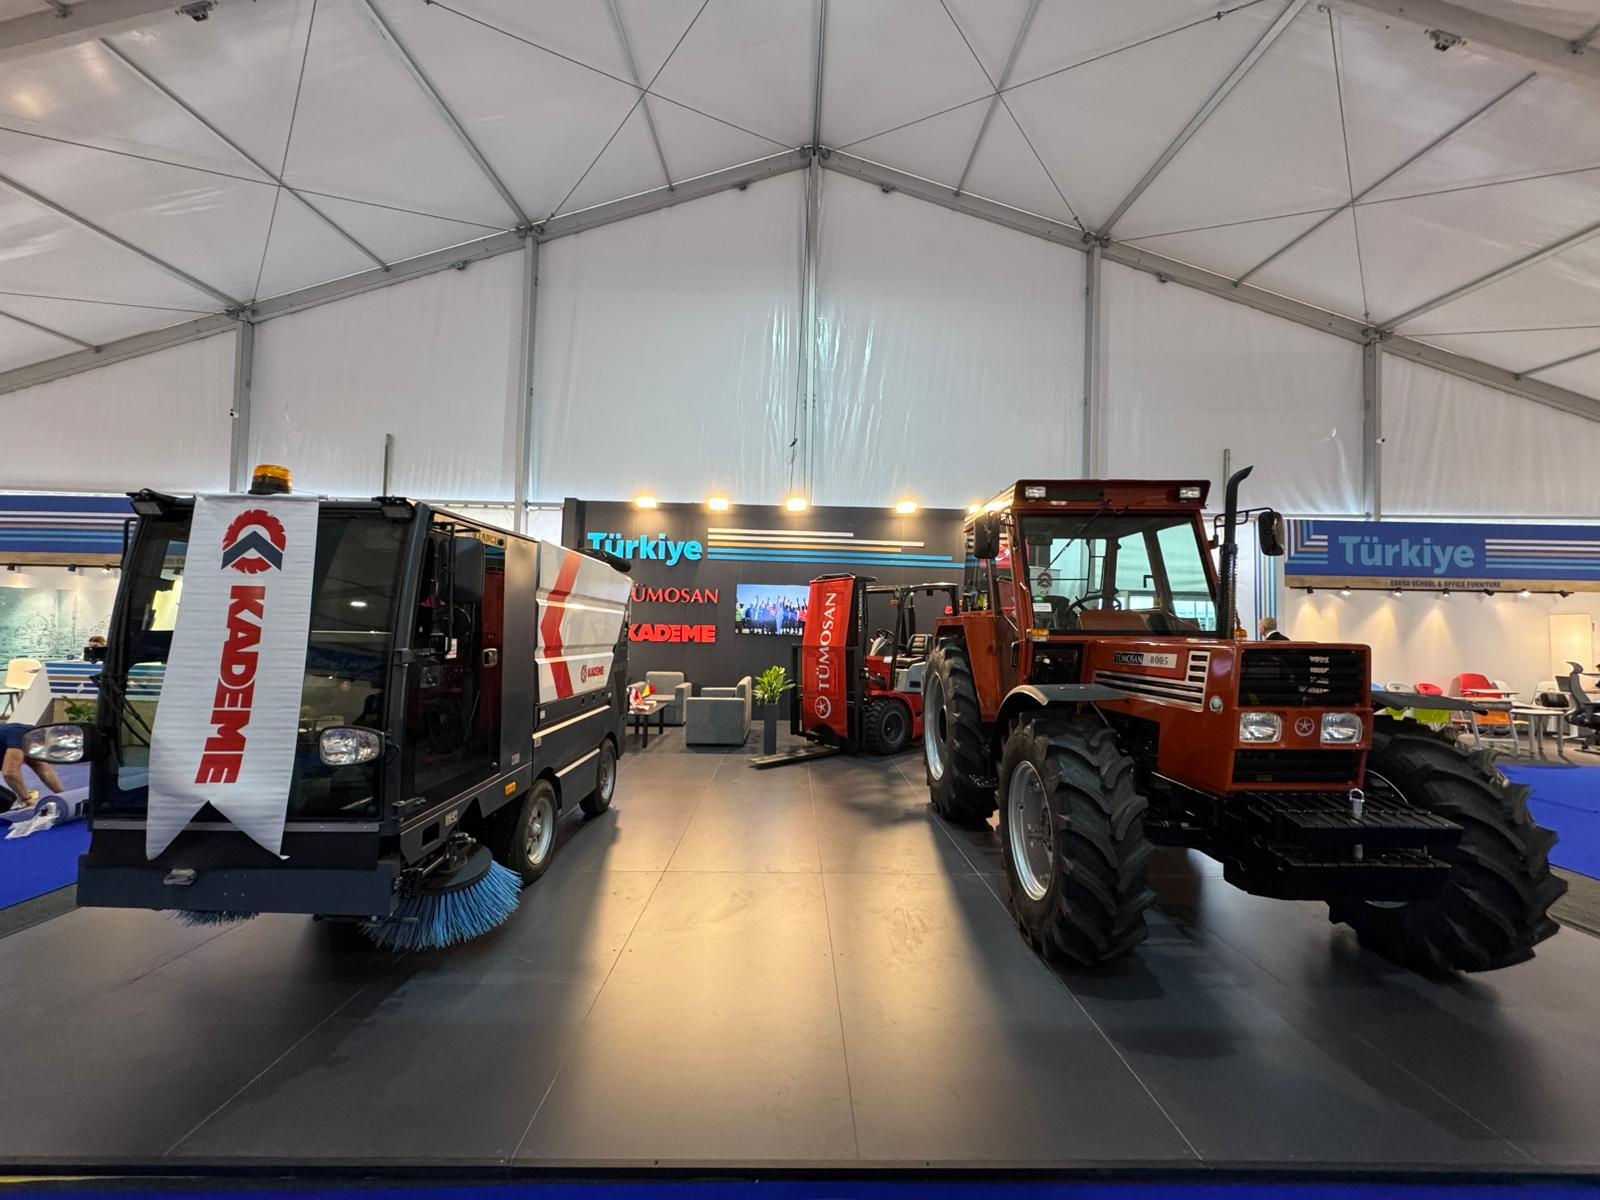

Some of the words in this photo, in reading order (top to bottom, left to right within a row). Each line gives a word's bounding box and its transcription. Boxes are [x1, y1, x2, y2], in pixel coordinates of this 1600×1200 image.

[587, 532, 703, 567] Türkiye
[1338, 535, 1475, 575] Türkiye
[631, 583, 719, 604] ÜMOSAN
[815, 592, 837, 690] TÜMOSAN
[1150, 655, 1169, 665] 8005
[193, 585, 266, 785] KADEME
